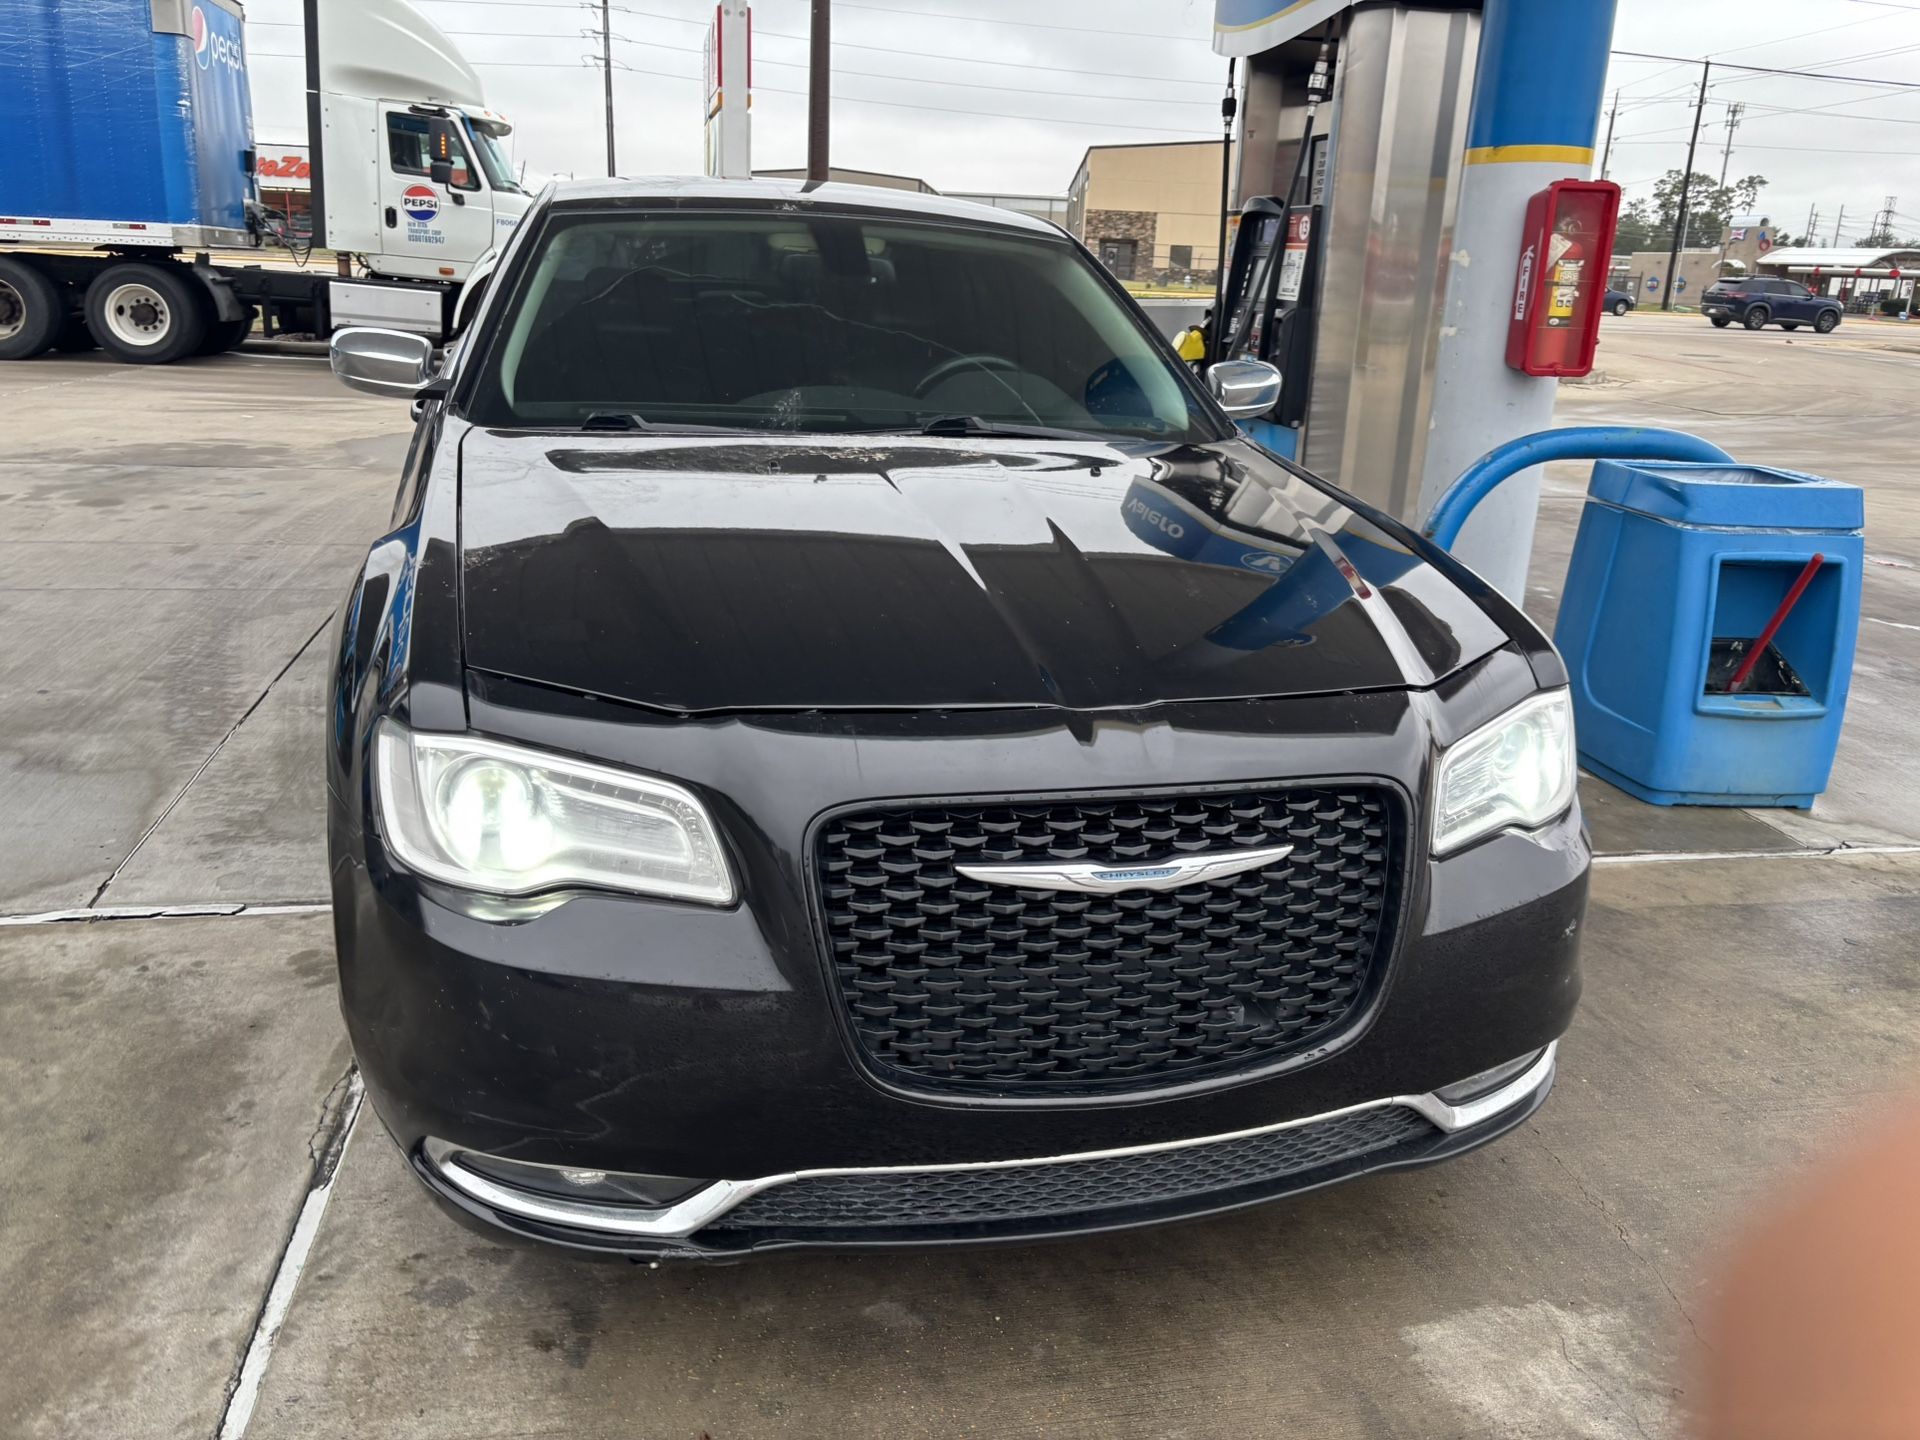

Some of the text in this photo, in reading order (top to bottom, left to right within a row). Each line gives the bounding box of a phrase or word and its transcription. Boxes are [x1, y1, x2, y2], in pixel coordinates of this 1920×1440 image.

[211, 32, 243, 74] pepsi
[257, 156, 310, 178] toZo
[404, 198, 437, 209] PEPSI
[1517, 265, 1529, 313] FIRE
[1100, 869, 1170, 879] CHRYSLER
